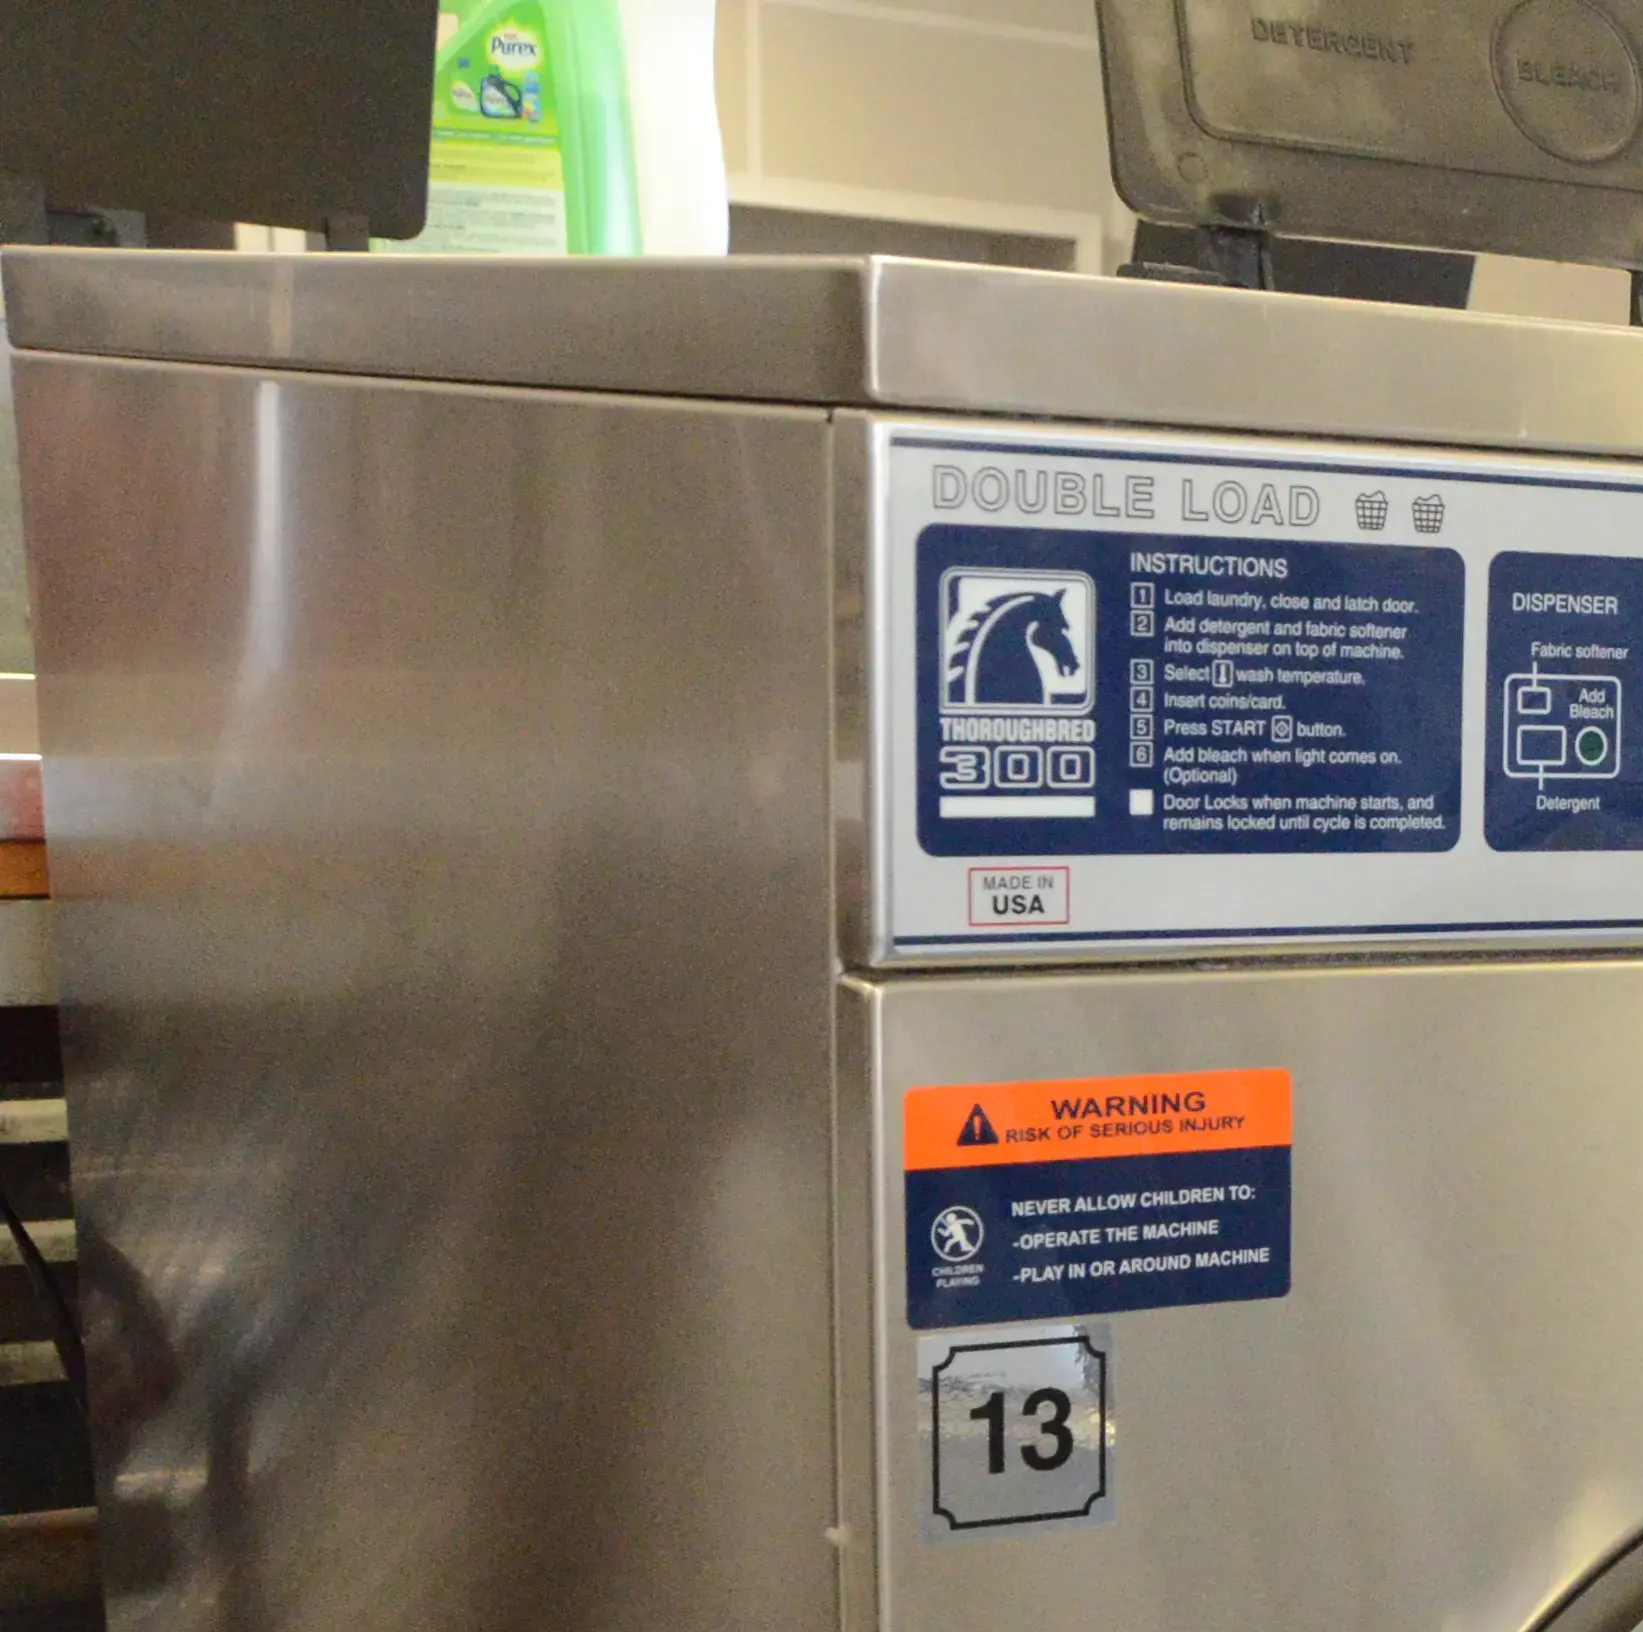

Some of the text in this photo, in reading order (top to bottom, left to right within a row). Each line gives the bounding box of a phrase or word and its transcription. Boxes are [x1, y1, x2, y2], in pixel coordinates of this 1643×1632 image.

[491, 35, 537, 57] Purex
[1250, 18, 1415, 65] DETERGENT
[933, 465, 1320, 527] DOUBLE LOAD
[1131, 553, 1287, 578] INSTRUCTIONS
[1165, 590, 1417, 614] Load laundry, close and latch door.
[1513, 593, 1617, 615] DISPENSER
[1165, 616, 1407, 640] Add detergent and fabric softener
[1165, 638, 1403, 659] into dispenser on top of machine.
[1531, 641, 1628, 660] Fabric softener
[1165, 665, 1364, 685] Select wash temperature.
[1164, 693, 1285, 710] Insert coins/card.
[1579, 688, 1605, 706] Add
[1570, 703, 1614, 720] Bleach
[941, 718, 1094, 742] THOROUGHBRED
[1164, 719, 1344, 737] Press START button.
[940, 745, 1095, 790] 300
[1164, 747, 1401, 768] Add bleach when light comes on.
[1164, 766, 1237, 786] (Optional)
[1164, 793, 1434, 810] Door Locks when machine starts, and
[1537, 796, 1601, 813] Detergent
[1163, 815, 1445, 833] remains locked until cycle is completed.
[983, 875, 1053, 890] MADE IN
[993, 894, 1044, 915] USA
[1051, 1092, 1205, 1119] WARNING
[1006, 1116, 1244, 1143] RISK OF SERIOUS INJURY
[1012, 1184, 1254, 1216] NEVER ALLOW CHILDREN TO:
[1014, 1219, 1218, 1250] -OPERATE THE MACHINE
[1014, 1248, 1269, 1283] -PLAY IN OR AROUND MACHINE
[970, 1389, 1073, 1473] 13
